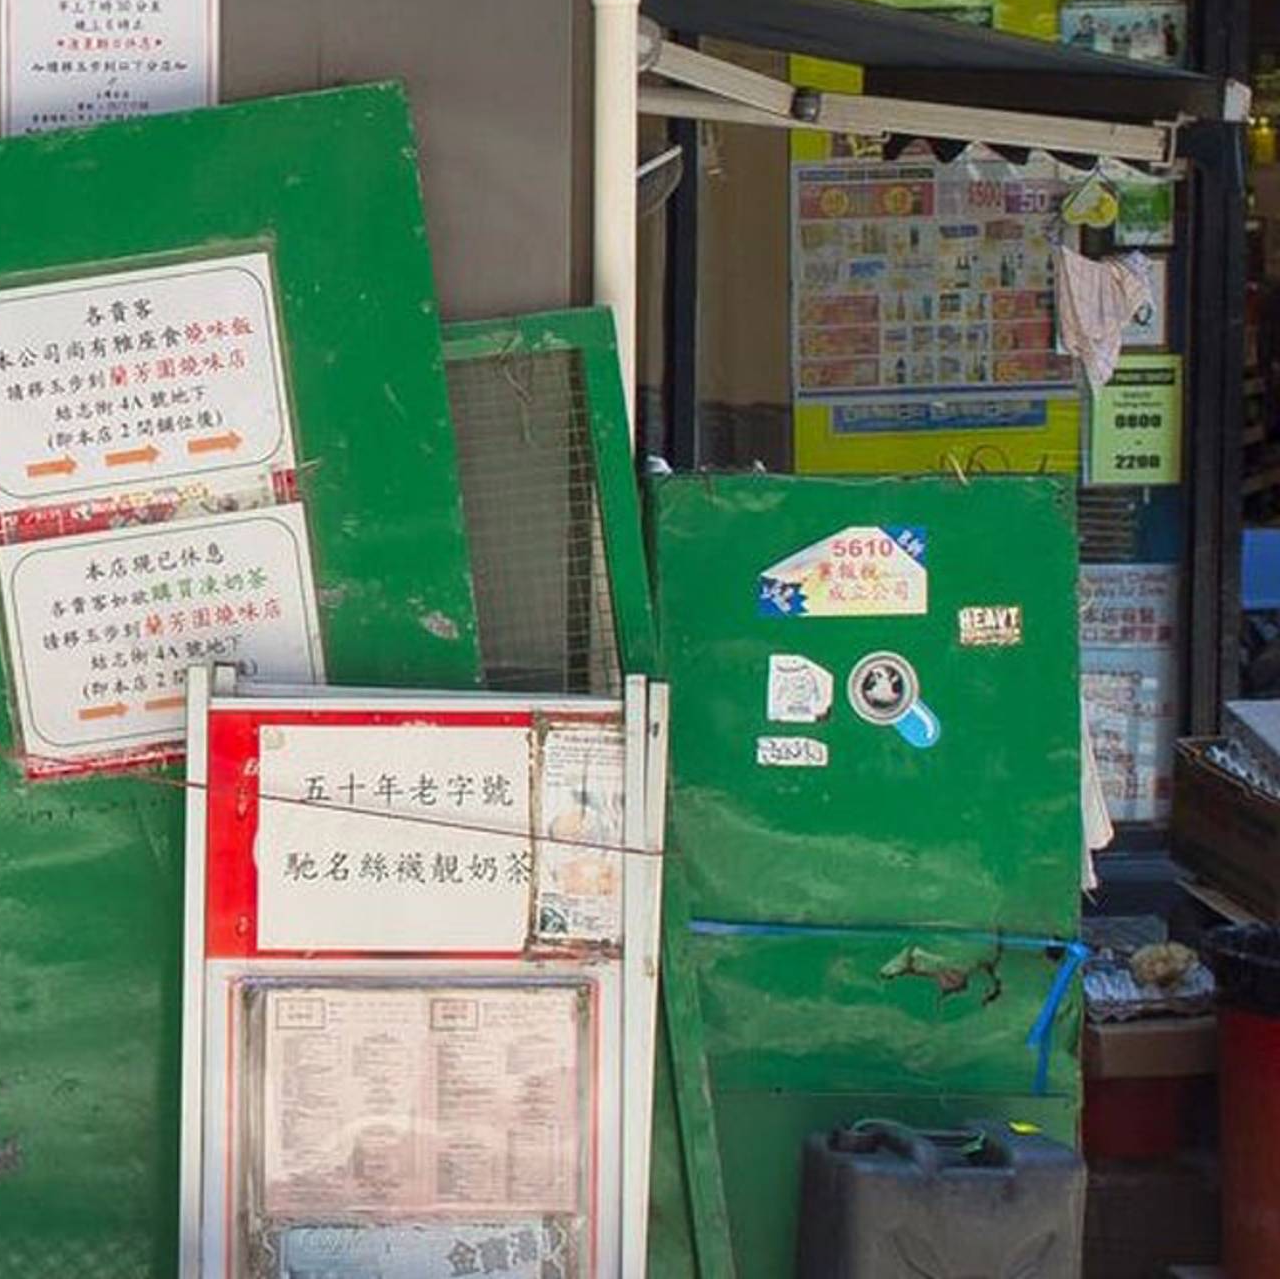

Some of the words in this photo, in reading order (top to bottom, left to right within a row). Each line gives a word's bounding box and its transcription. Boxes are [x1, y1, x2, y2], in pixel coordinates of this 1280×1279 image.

[831, 538, 894, 558] 5610
[304, 772, 514, 807] 五十年老字號
[284, 852, 532, 884] 馳名絲襪靚奶茶
